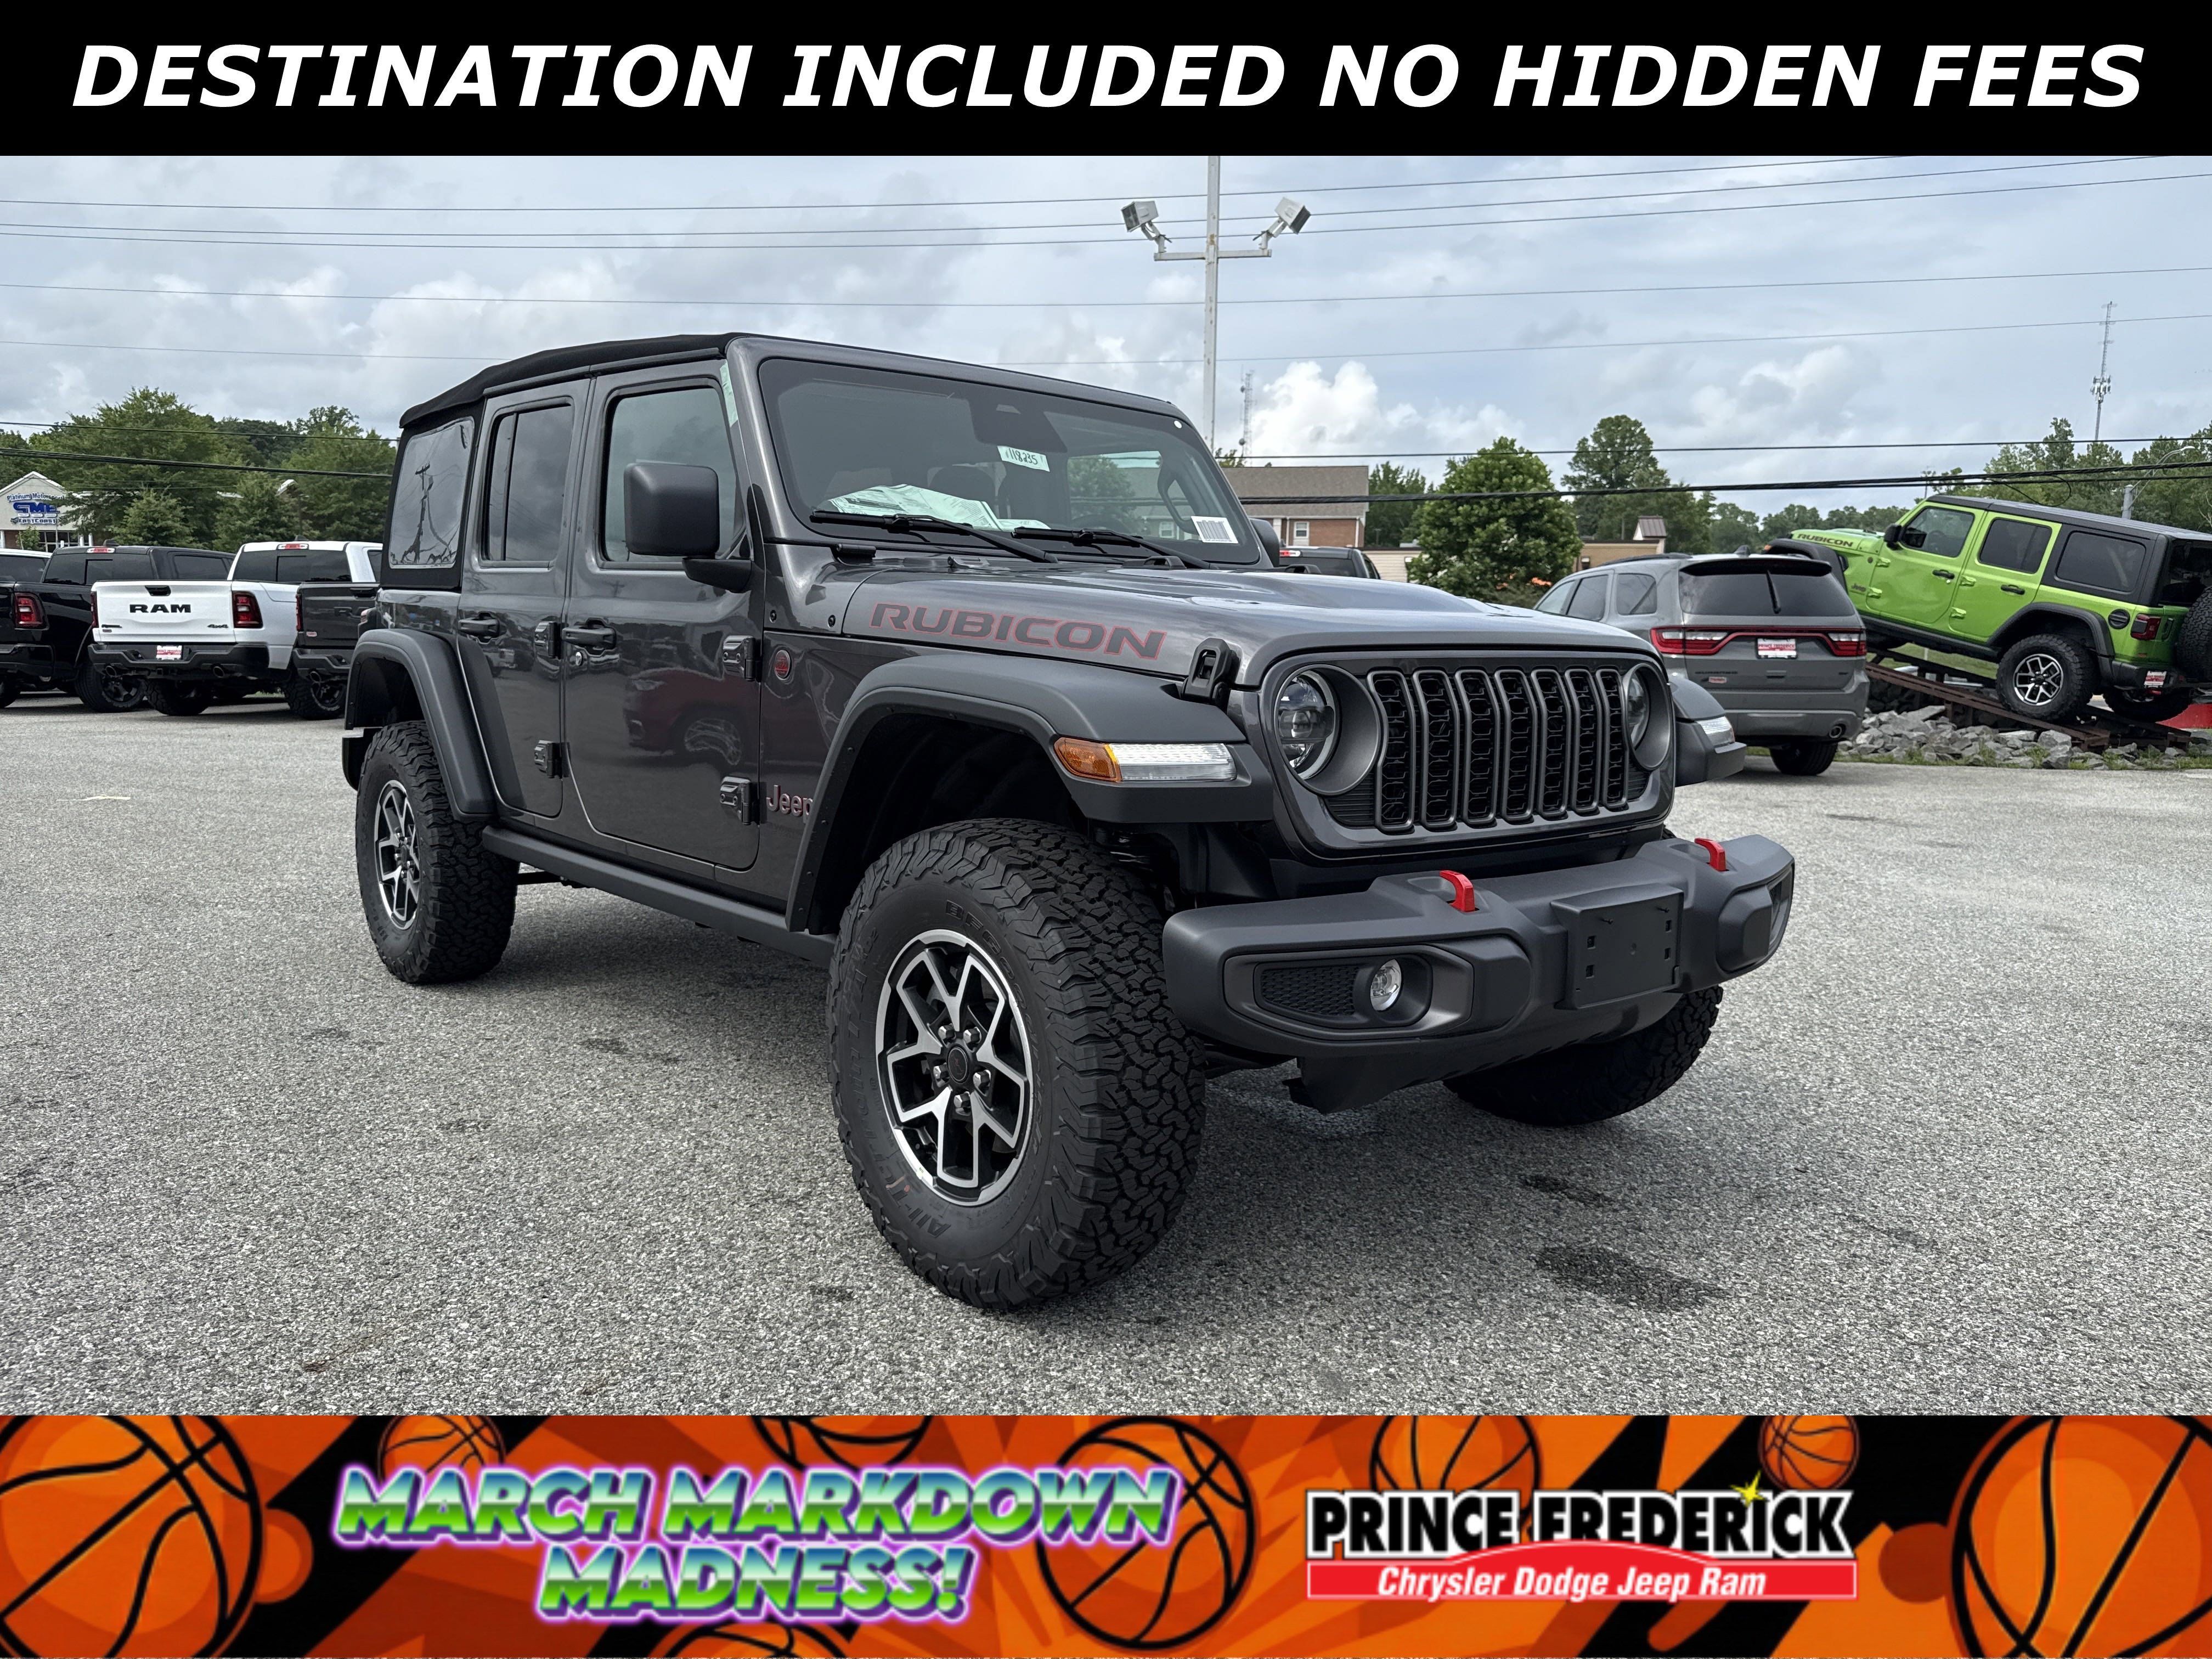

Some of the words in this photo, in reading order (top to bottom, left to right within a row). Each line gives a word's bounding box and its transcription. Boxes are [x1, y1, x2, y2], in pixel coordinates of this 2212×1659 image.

[1008, 448, 1039, 465] 118235
[1797, 533, 1854, 548] RUBICON
[129, 604, 191, 613] RAM
[869, 602, 1167, 660] RUBICON
[766, 784, 813, 823] Jeep
